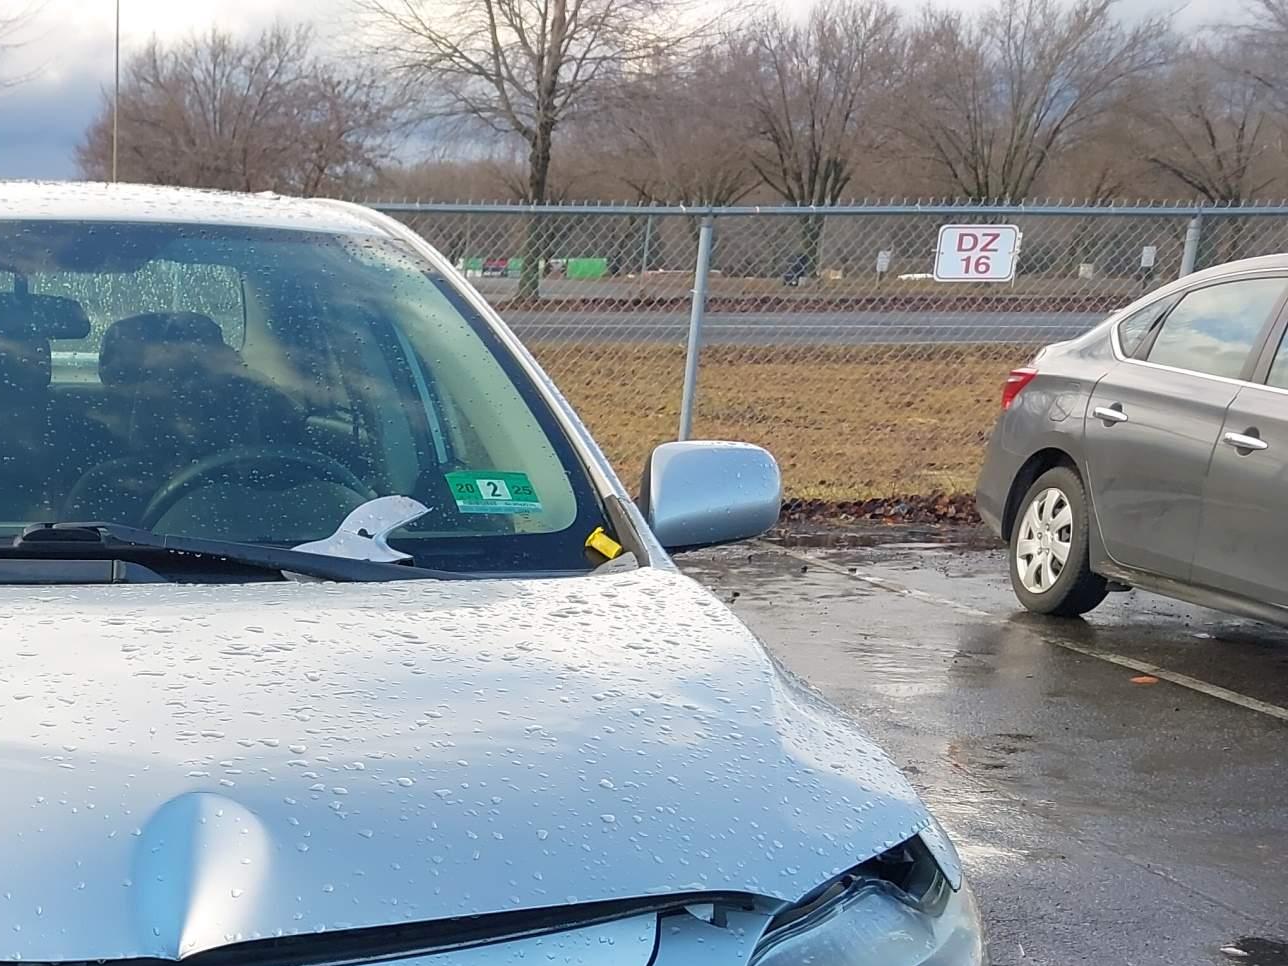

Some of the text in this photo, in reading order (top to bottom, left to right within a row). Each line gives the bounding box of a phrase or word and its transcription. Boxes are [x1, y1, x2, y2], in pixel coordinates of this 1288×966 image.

[957, 233, 1001, 252] DZ
[960, 255, 991, 274] 16
[455, 481, 533, 497] 20 2 25
